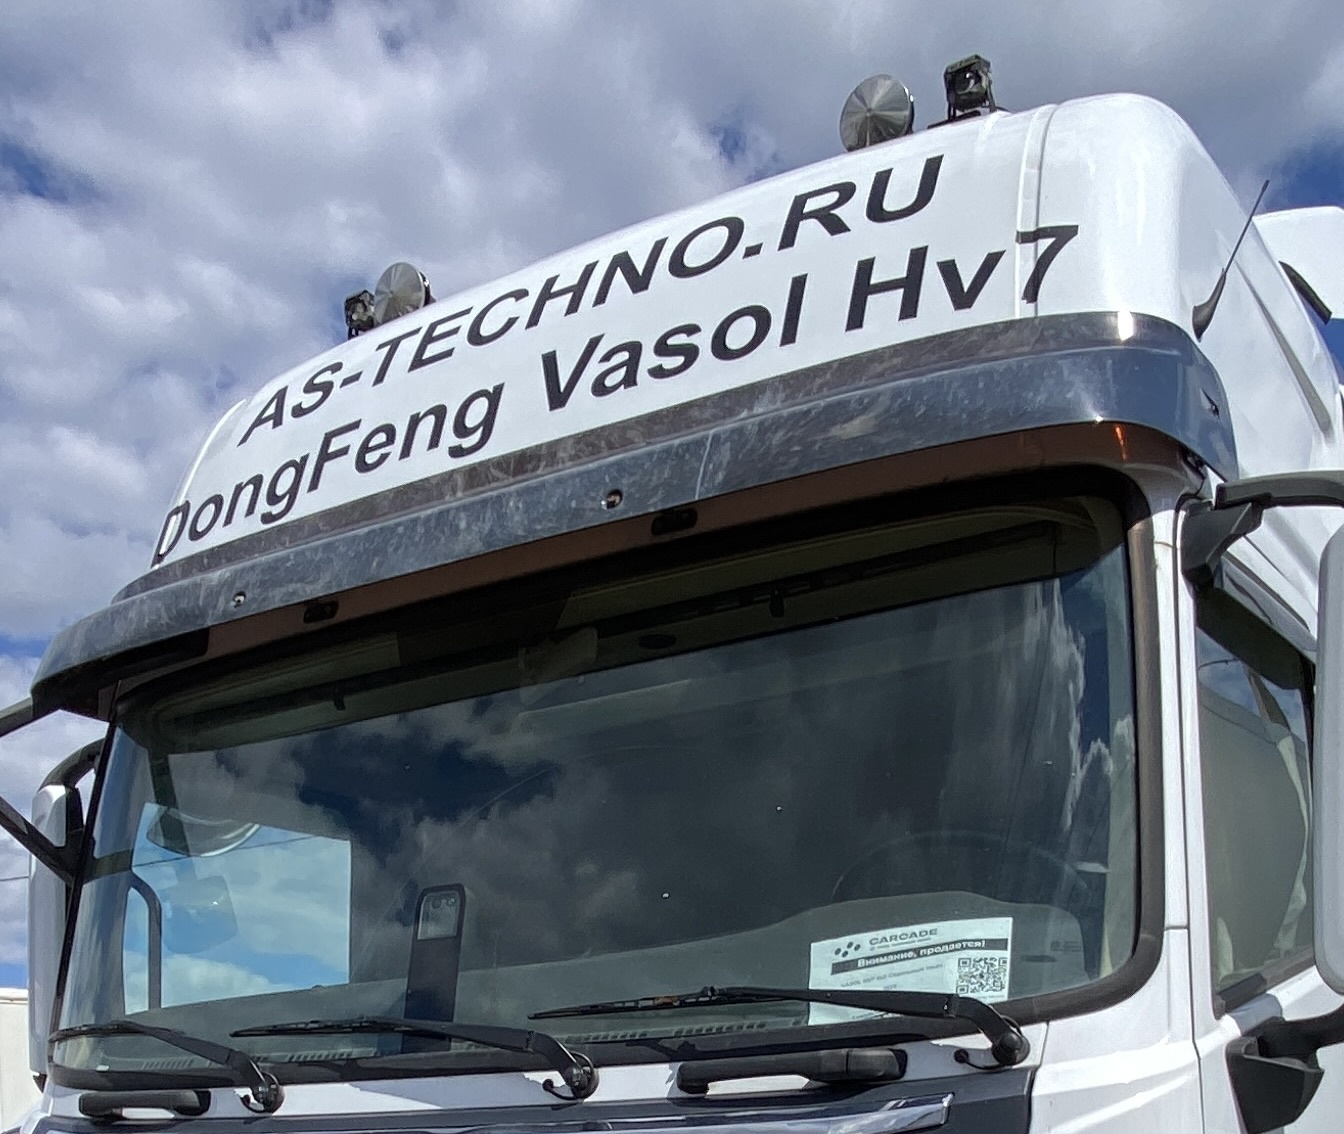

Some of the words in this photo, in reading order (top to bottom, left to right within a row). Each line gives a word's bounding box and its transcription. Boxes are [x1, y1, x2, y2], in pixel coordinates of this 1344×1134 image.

[237, 154, 944, 447] AS-TECHNO.RU
[151, 382, 505, 567] DongFeng
[541, 273, 808, 413] Vasol
[845, 224, 1079, 332] Hv7
[856, 949, 917, 968] Внимание,
[919, 939, 986, 958] продается!
[868, 928, 938, 946] CARCADE
